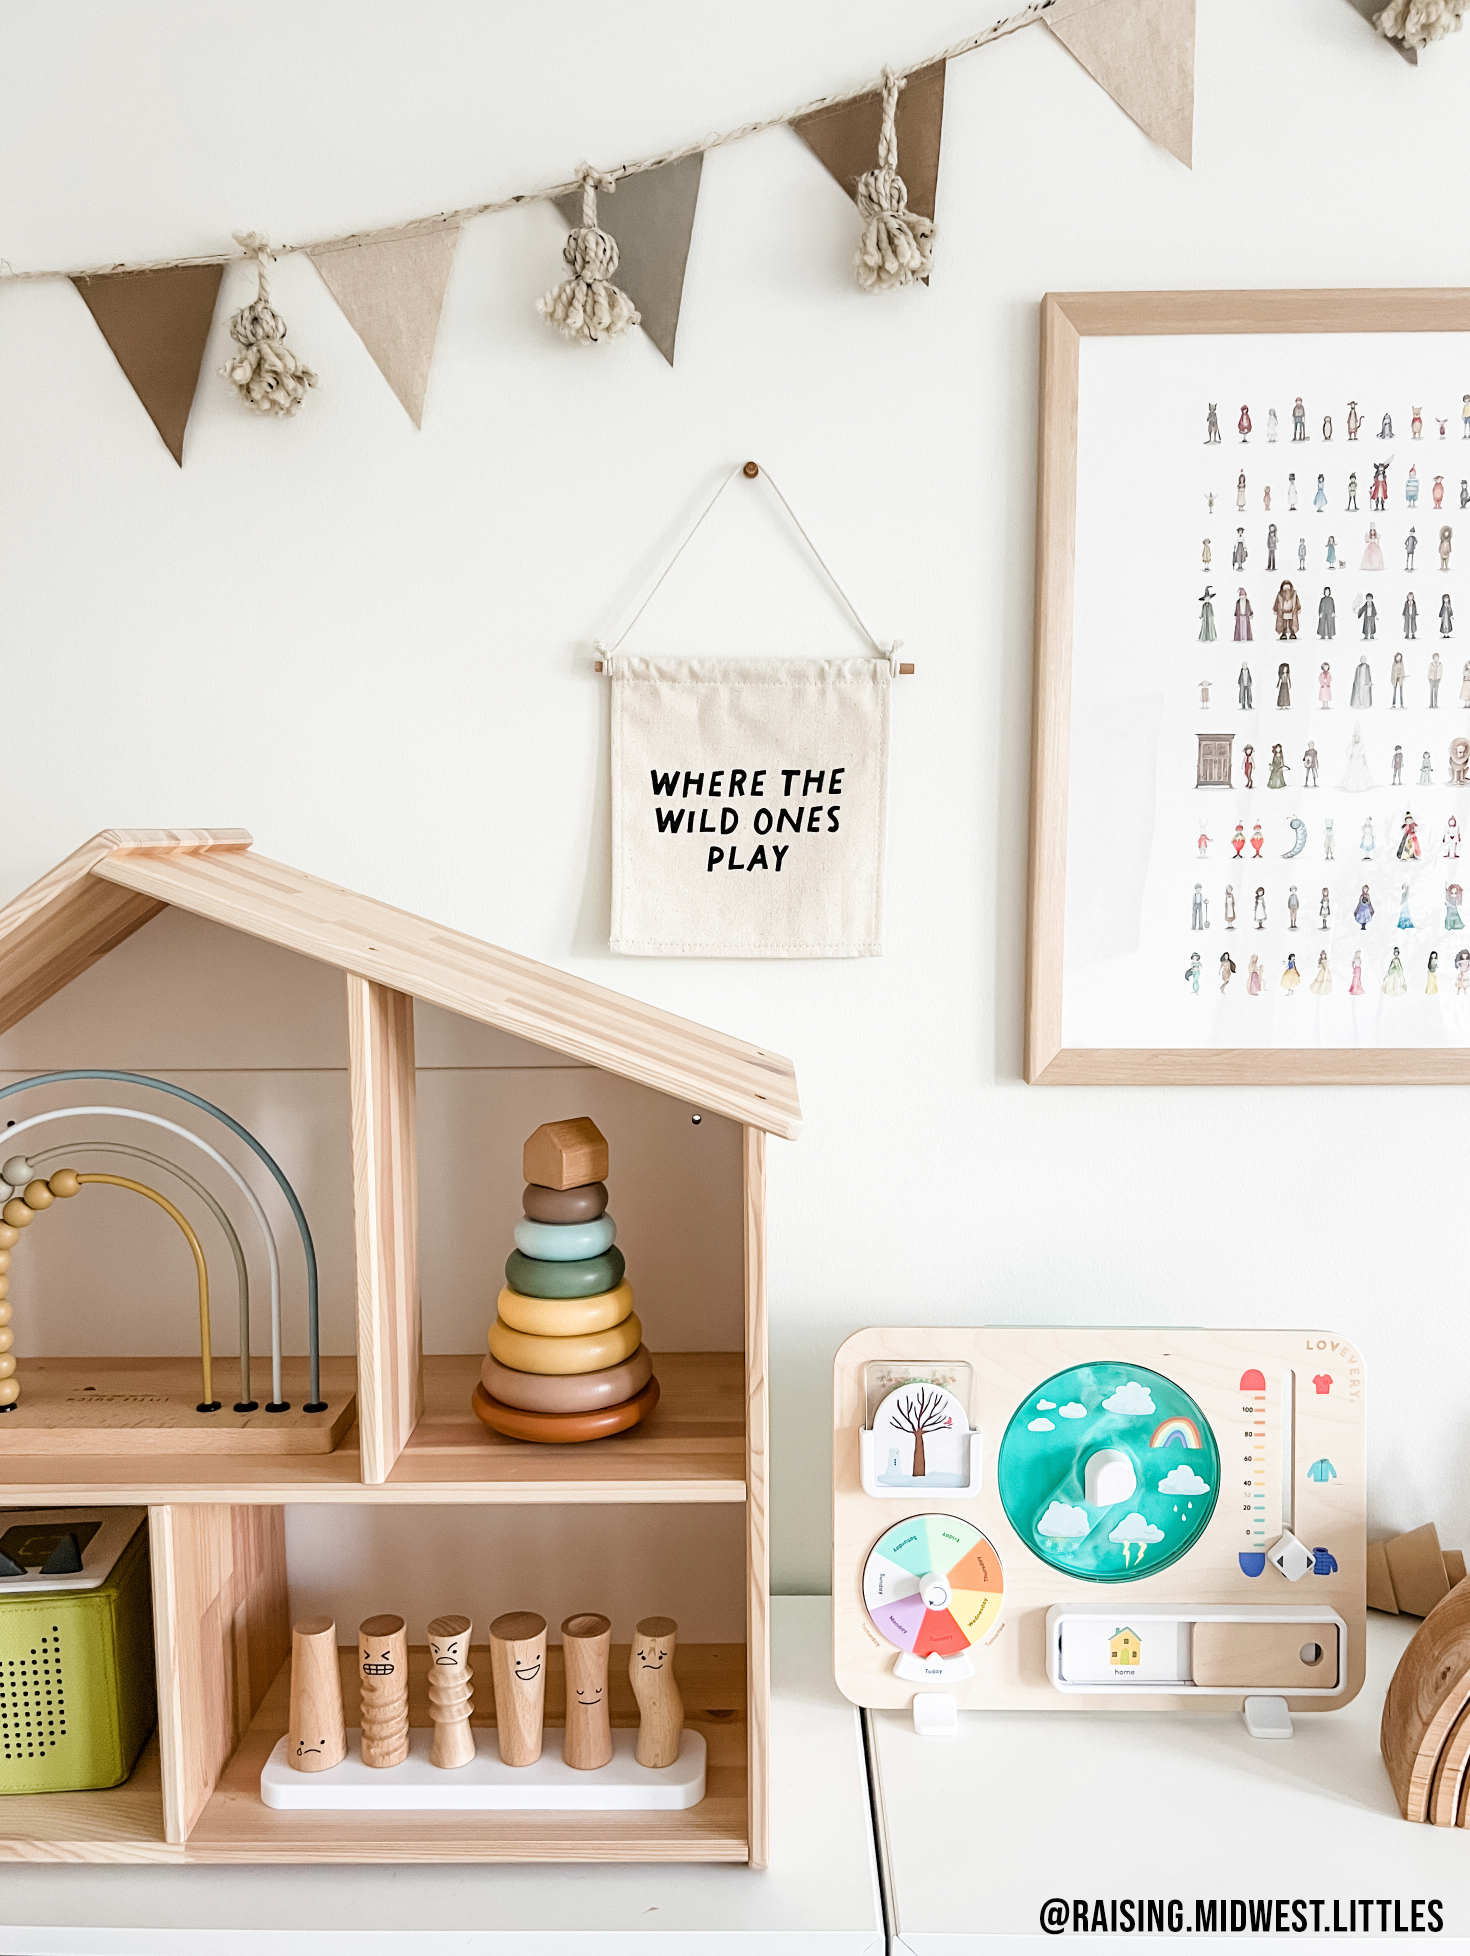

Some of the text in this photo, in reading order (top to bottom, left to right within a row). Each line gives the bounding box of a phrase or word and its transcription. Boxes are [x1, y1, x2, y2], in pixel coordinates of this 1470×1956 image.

[650, 767, 845, 798] WHERE THE
[655, 805, 840, 835] WILD ONES
[707, 844, 789, 872] PLAY
[966, 1597, 989, 1627] Wednesday
